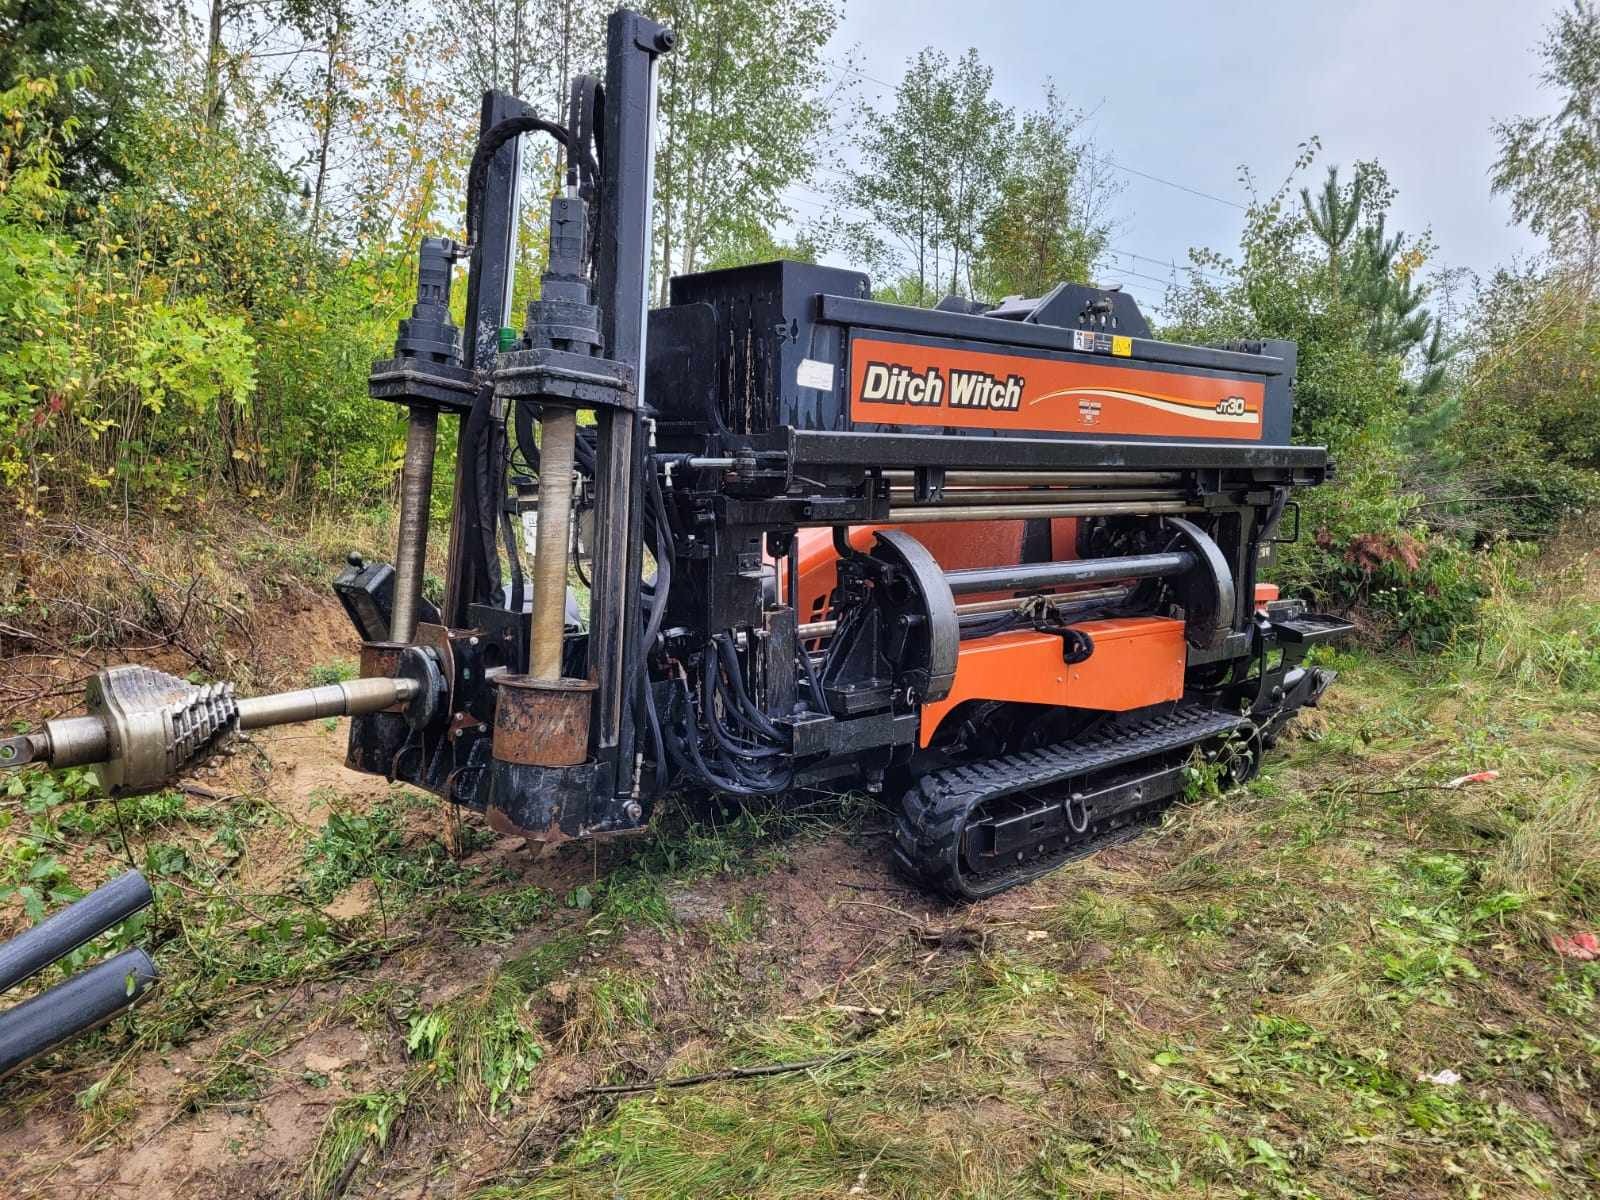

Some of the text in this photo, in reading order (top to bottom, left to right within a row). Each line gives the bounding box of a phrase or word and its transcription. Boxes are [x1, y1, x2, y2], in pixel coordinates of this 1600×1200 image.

[862, 364, 1022, 409] Ditch Witch
[1216, 397, 1245, 415] JT30
